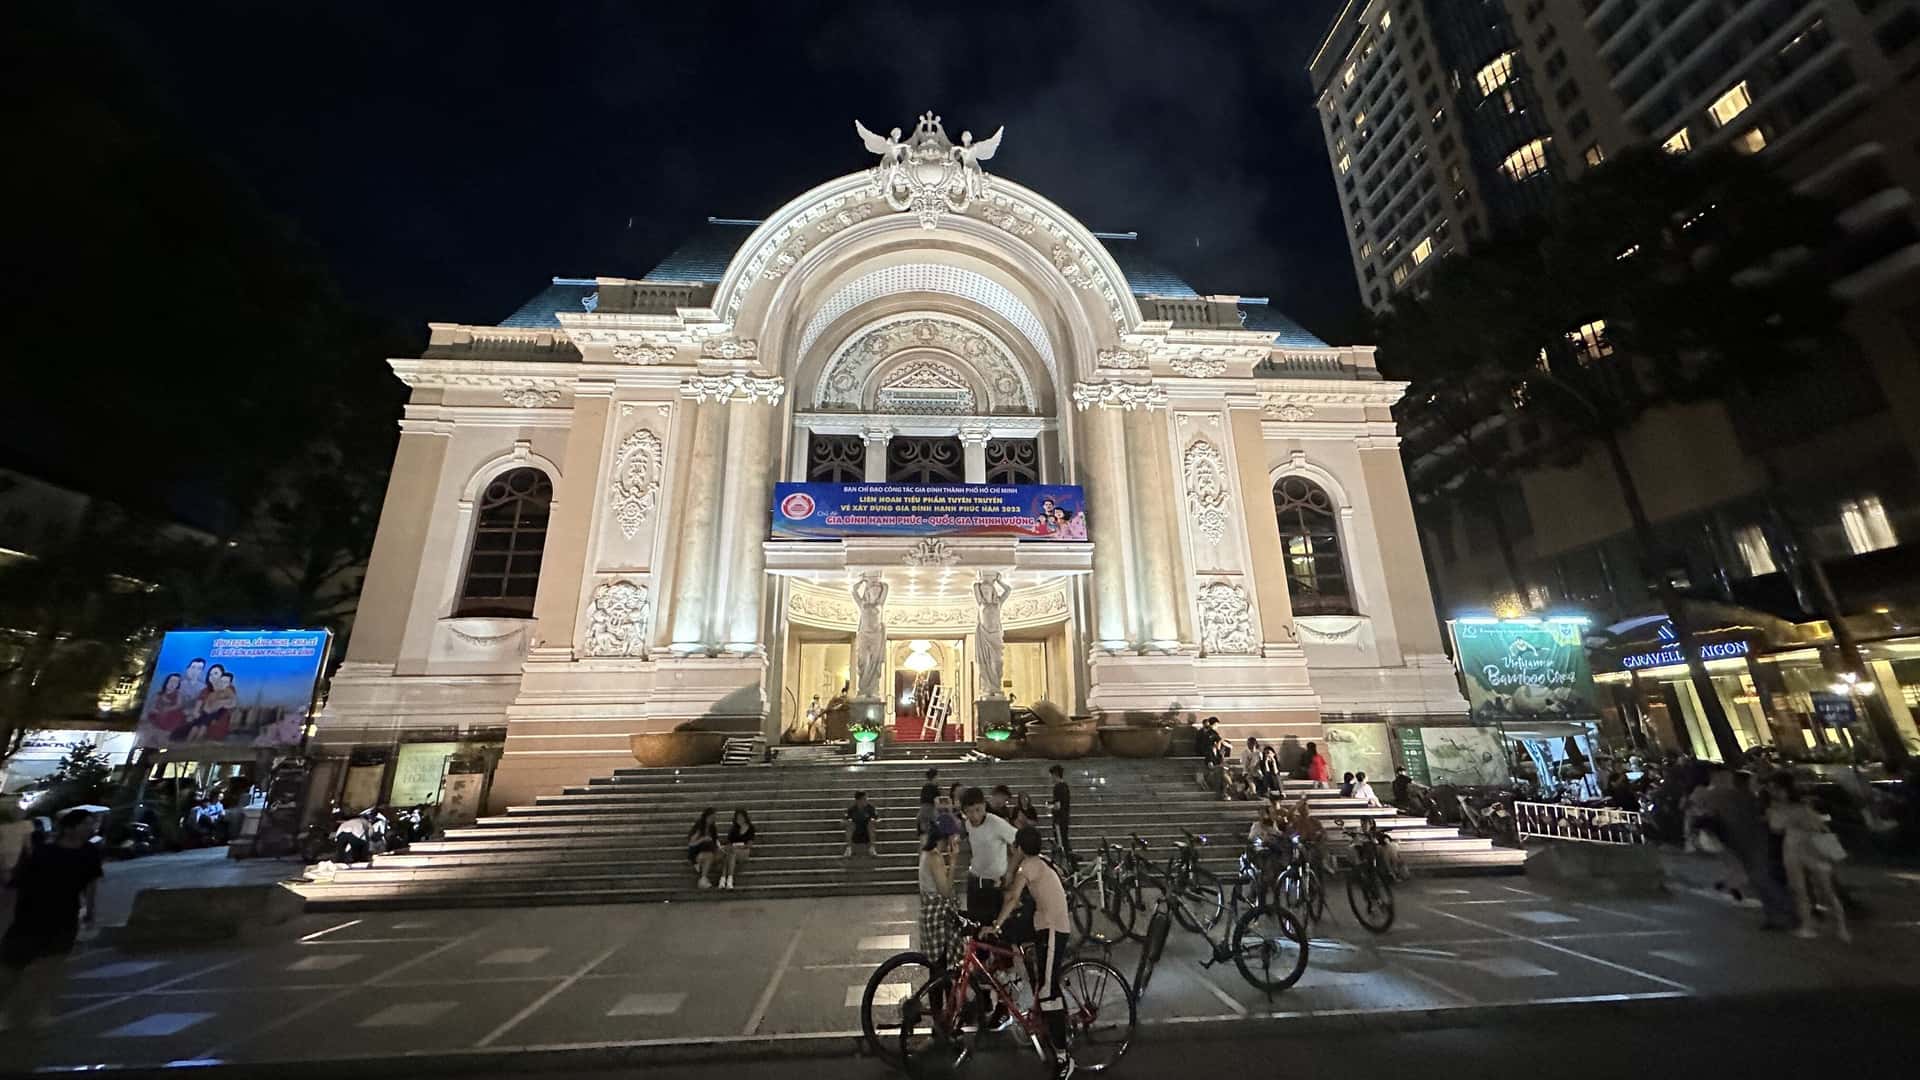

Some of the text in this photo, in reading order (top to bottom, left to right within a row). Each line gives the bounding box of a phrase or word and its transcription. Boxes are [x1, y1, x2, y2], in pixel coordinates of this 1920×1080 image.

[826, 516, 843, 525] GIA
[844, 514, 868, 525] ĐÌNH
[897, 515, 922, 525] PHÚC
[955, 516, 972, 525] GIA
[1623, 640, 1749, 667] CARAVELL AIGON
[1483, 664, 1545, 686] Bamboo
